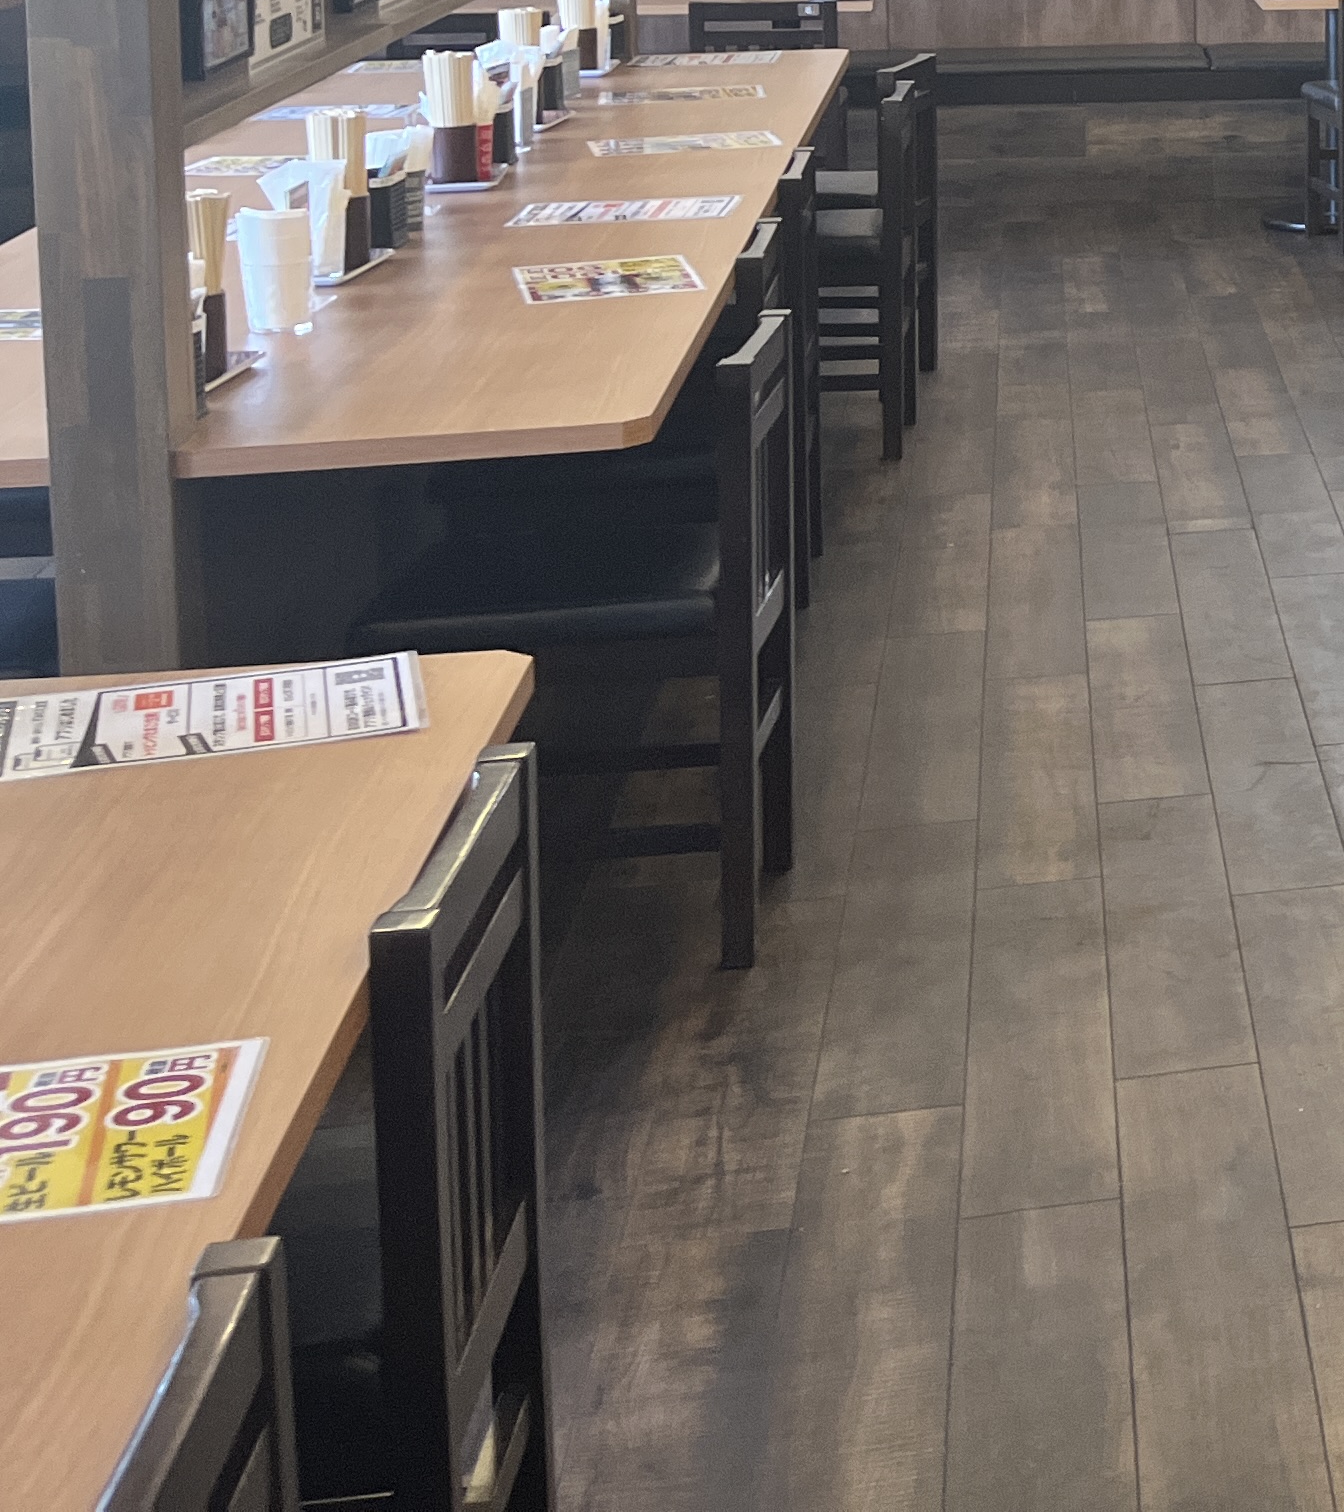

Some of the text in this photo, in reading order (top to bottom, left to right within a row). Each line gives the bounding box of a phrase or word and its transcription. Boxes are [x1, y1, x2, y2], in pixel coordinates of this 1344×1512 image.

[4, 1151, 56, 1212] 生ビール
[104, 1129, 149, 1203] レモンサワー
[151, 1134, 191, 1194] ハイボール
